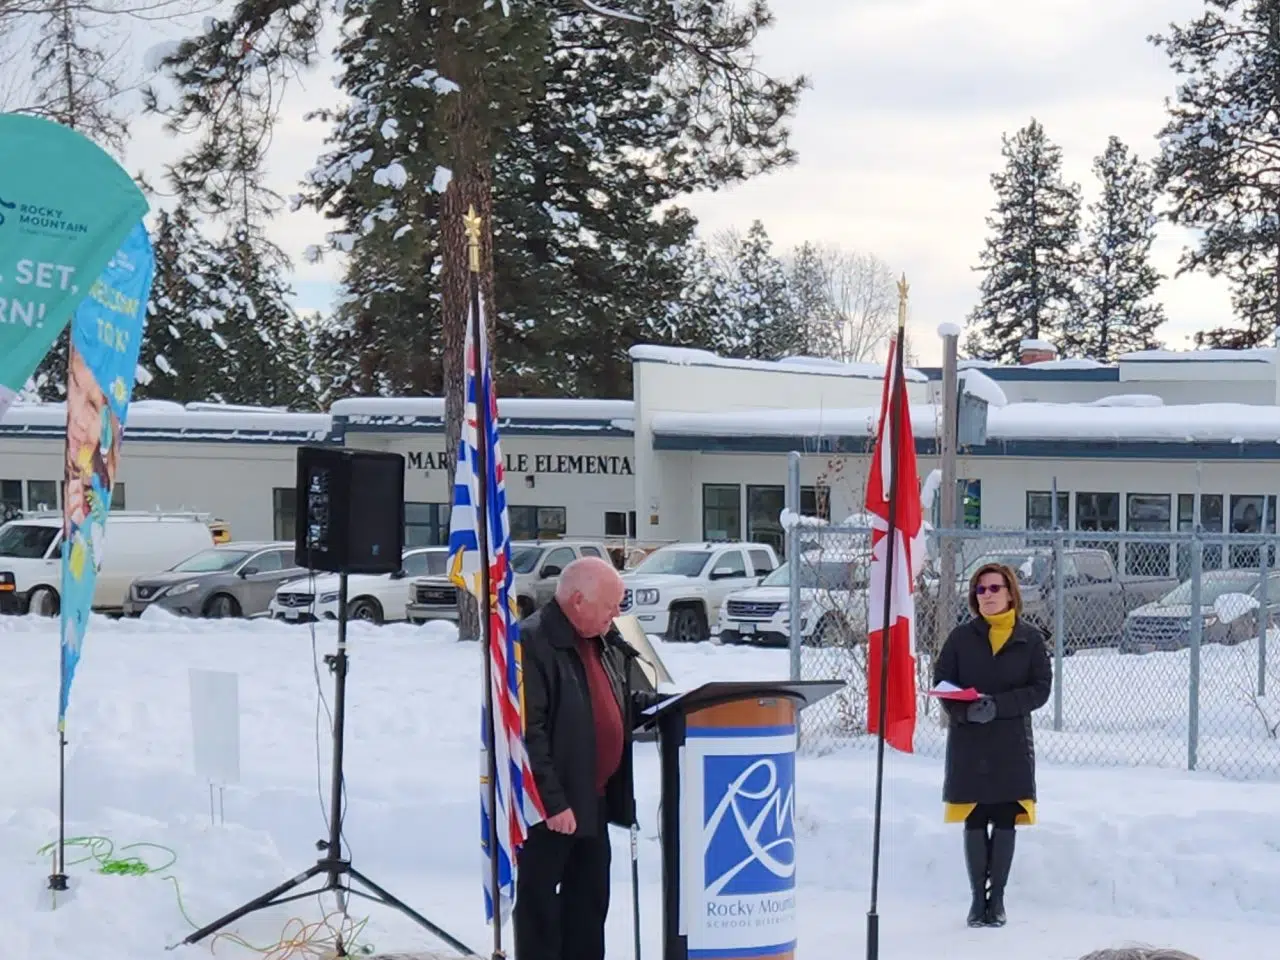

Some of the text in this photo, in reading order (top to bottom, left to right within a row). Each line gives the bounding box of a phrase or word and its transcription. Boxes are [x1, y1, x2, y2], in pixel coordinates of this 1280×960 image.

[20, 203, 63, 218] ROCKY
[19, 214, 88, 234] MOUNTAIN
[15, 258, 79, 295] SET,
[535, 454, 635, 475] ELEMENTA
[707, 900, 754, 917] Rocky
